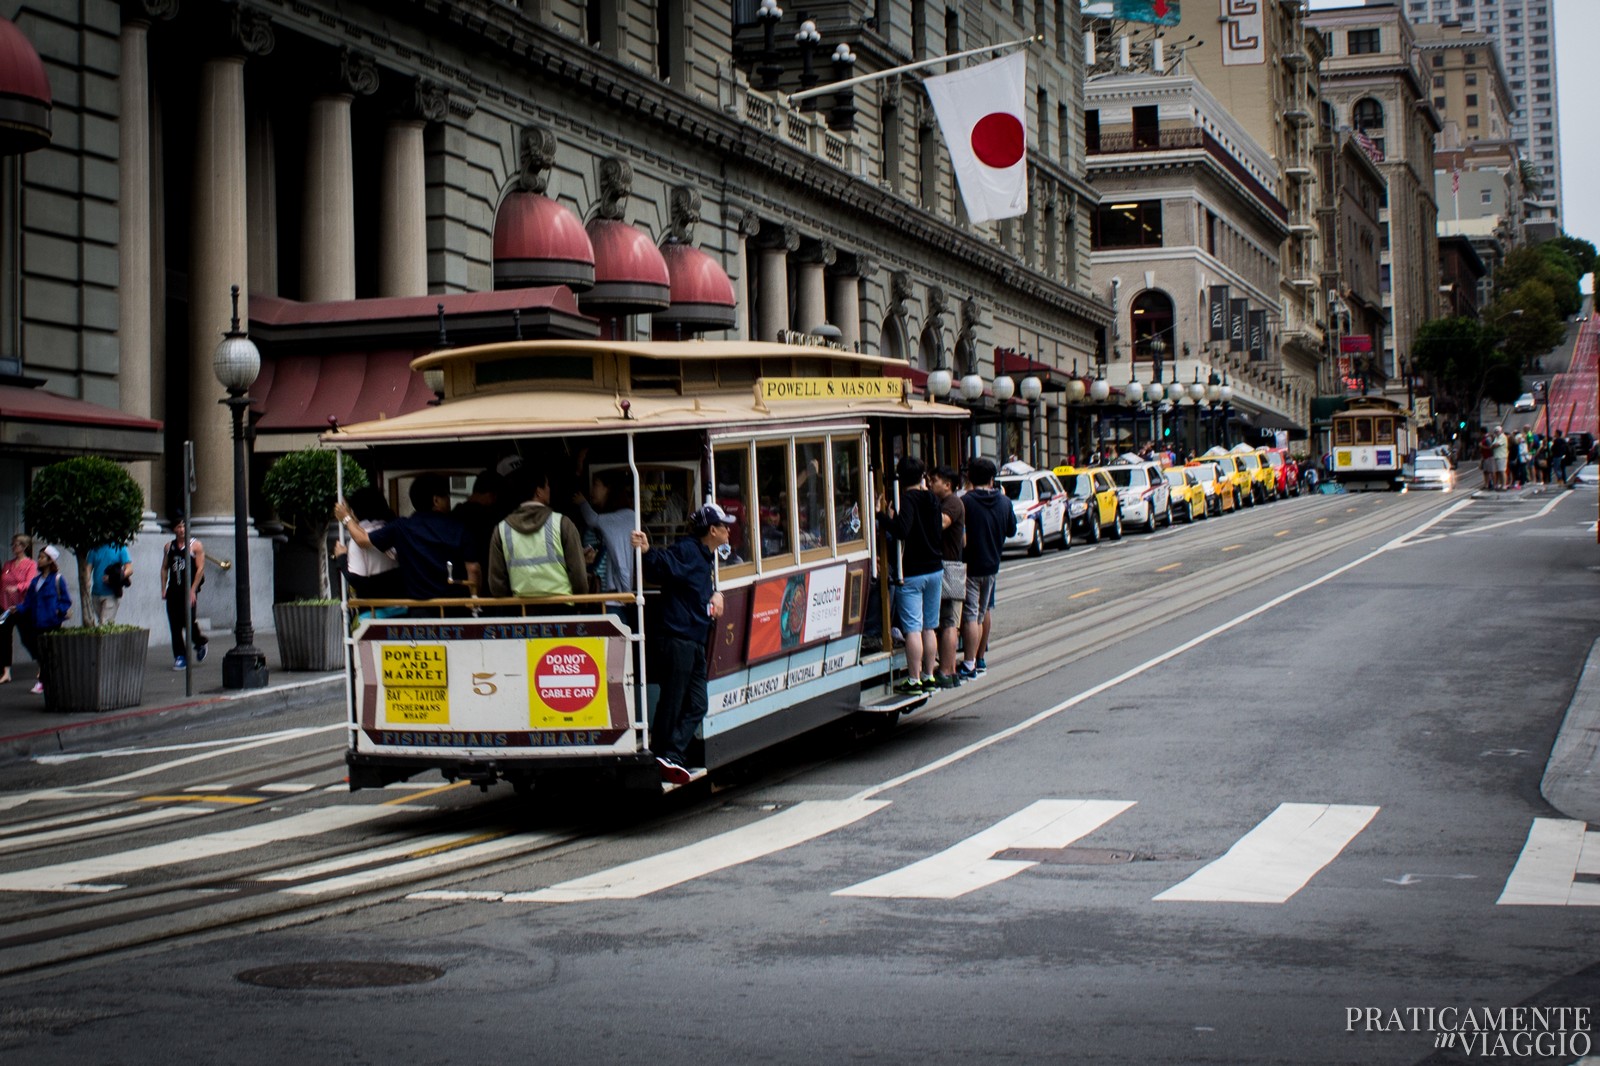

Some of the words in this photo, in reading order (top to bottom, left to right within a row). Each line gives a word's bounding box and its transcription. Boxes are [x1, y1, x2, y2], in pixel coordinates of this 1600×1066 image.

[1212, 302, 1222, 328] DSW
[1232, 315, 1242, 340] DSW
[1251, 326, 1261, 350] DSW
[767, 381, 821, 397] POWELL
[827, 381, 835, 395] &
[841, 381, 882, 396] MASON
[813, 585, 836, 607] swatch
[386, 626, 465, 641] MARKET
[483, 623, 568, 639] STREET
[726, 622, 735, 646] 5
[385, 651, 442, 661] POWELL
[546, 655, 562, 665] DO
[564, 654, 587, 664] NOT
[400, 661, 428, 669] AND
[553, 664, 580, 674] PASS
[384, 669, 444, 680] MARKET
[472, 672, 498, 696] 5
[386, 689, 401, 701] BAY
[415, 689, 446, 701] TAYLOR
[541, 689, 571, 698] CABLE
[574, 688, 594, 698] CAR
[722, 691, 738, 708] SAN
[392, 703, 441, 711] FISHERMANS
[404, 712, 428, 720] WHARF
[382, 731, 507, 747] FISHERMANS
[529, 731, 601, 746] WHARF
